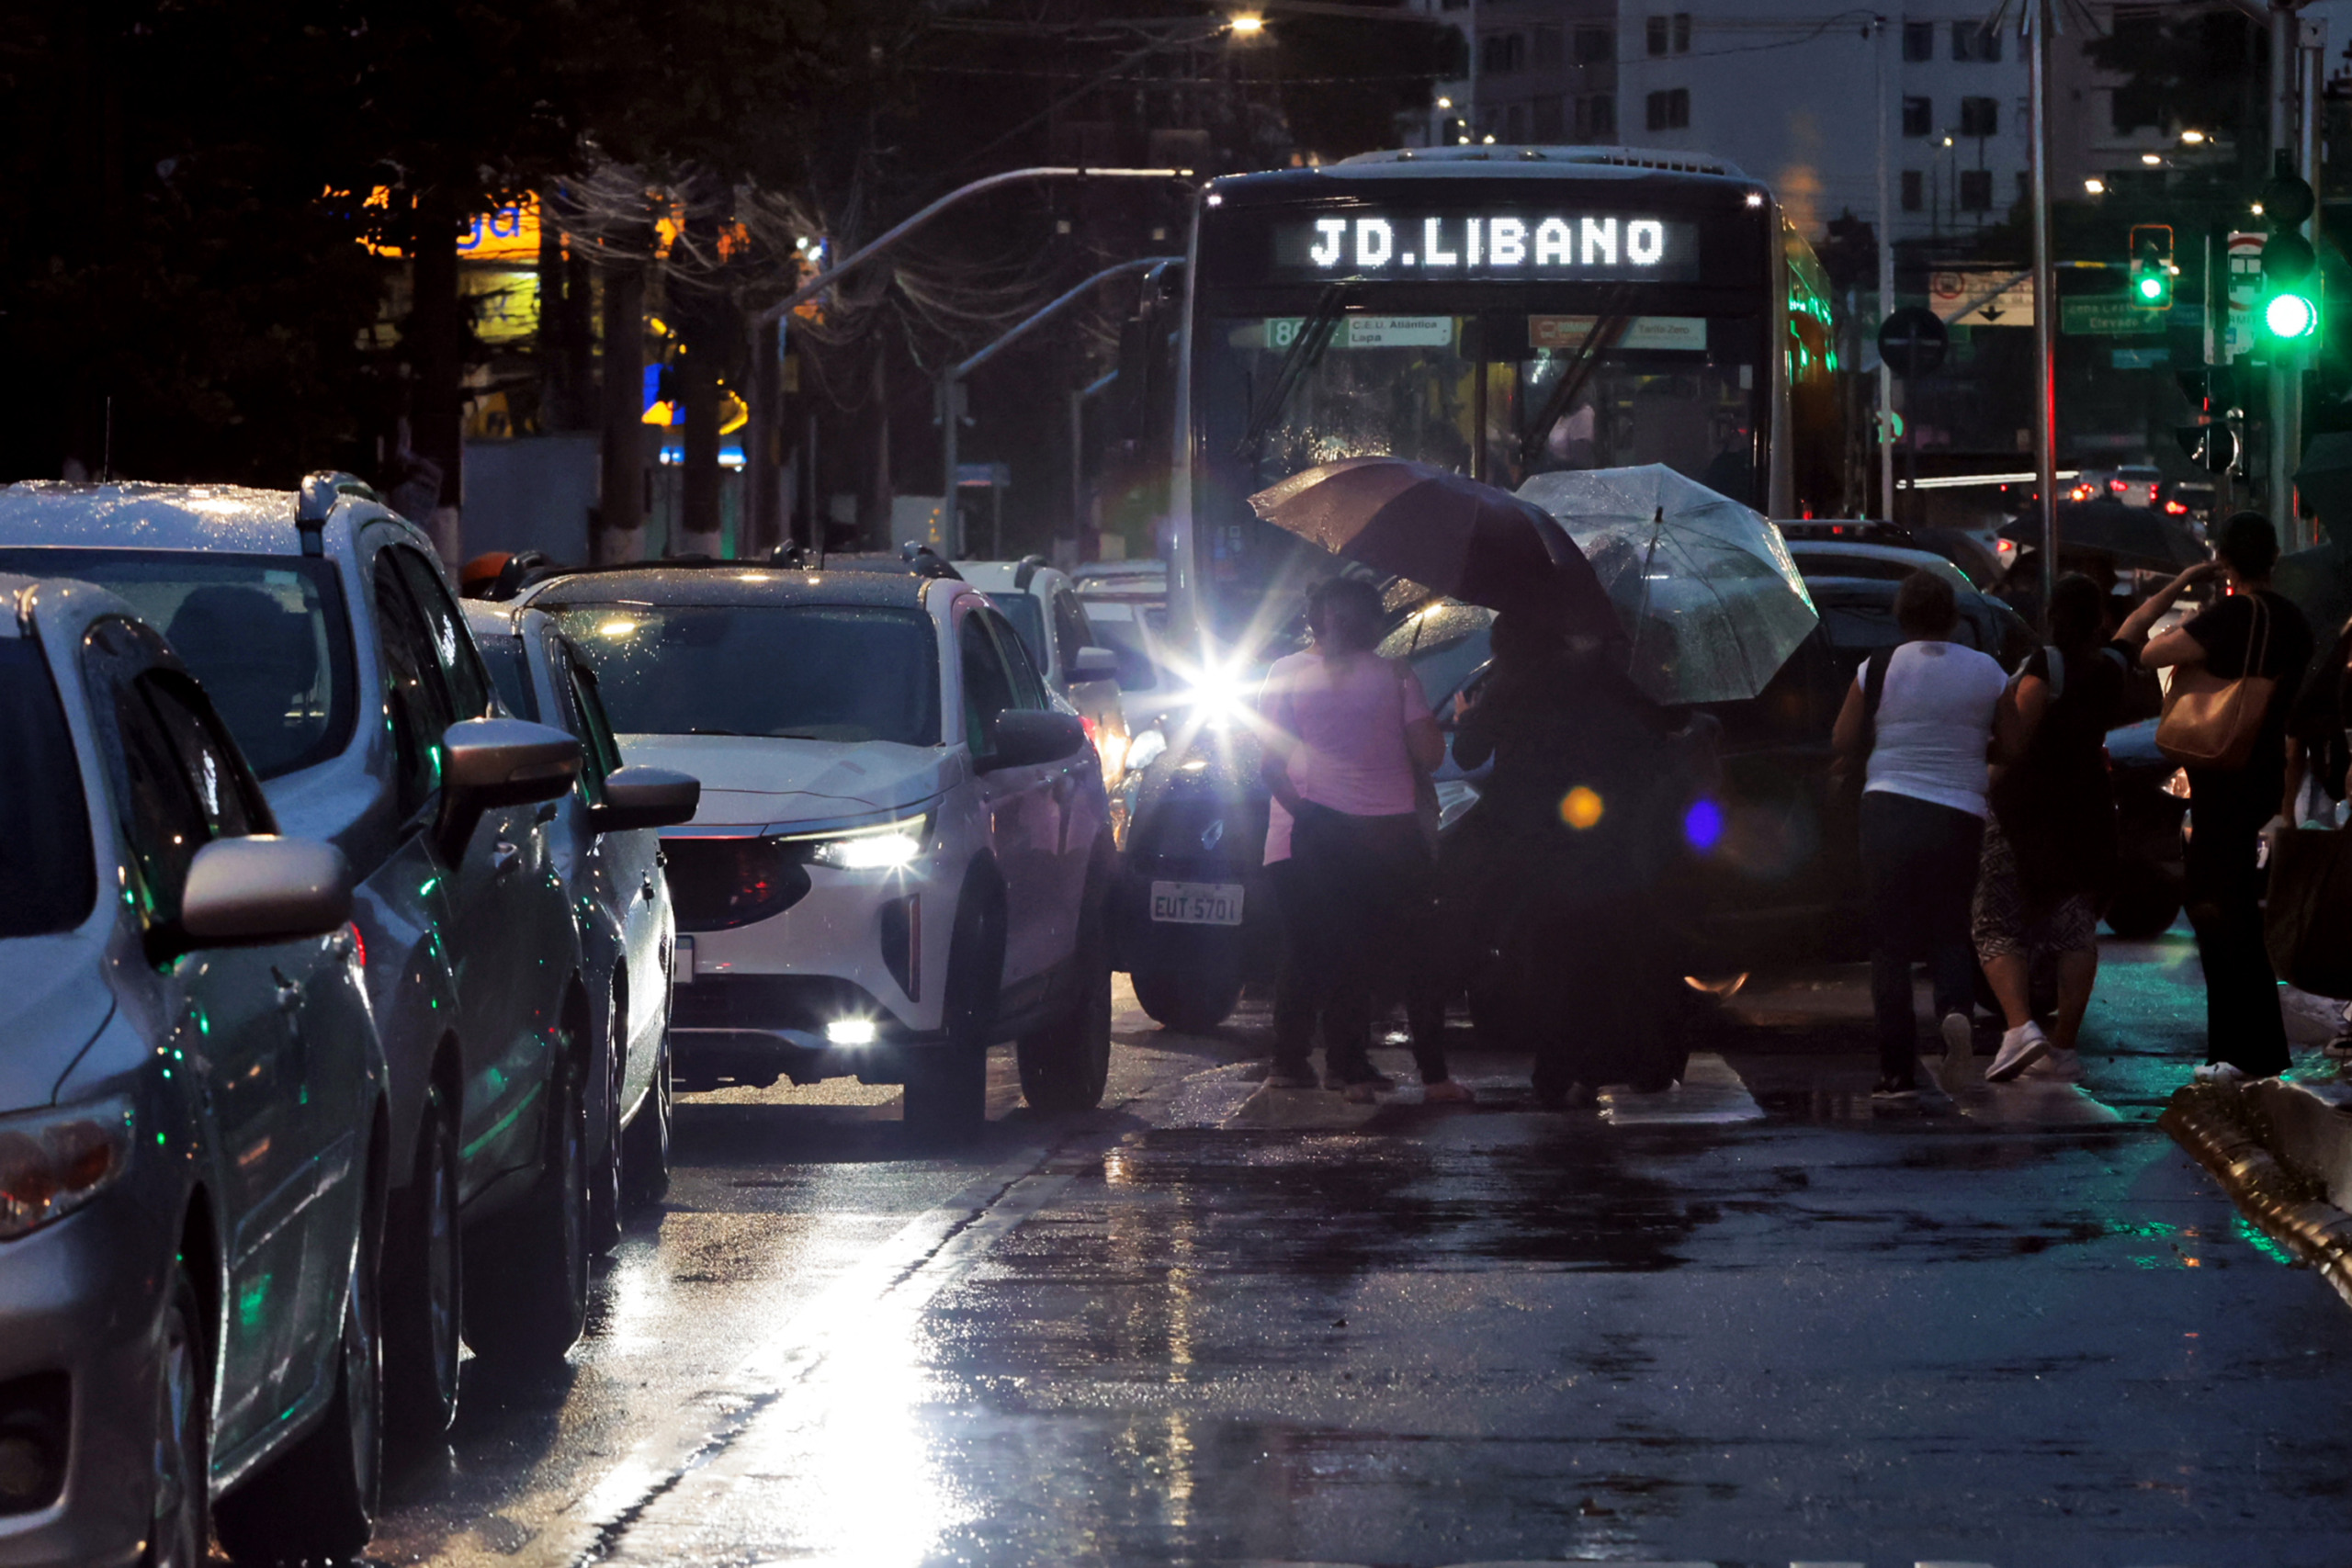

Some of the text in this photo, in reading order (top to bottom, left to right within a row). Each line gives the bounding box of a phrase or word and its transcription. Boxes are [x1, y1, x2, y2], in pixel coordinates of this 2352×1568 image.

[1310, 217, 1664, 266] JD.LIBANO
[1668, 324, 1690, 334] Zero
[1351, 333, 1383, 344] Lapa
